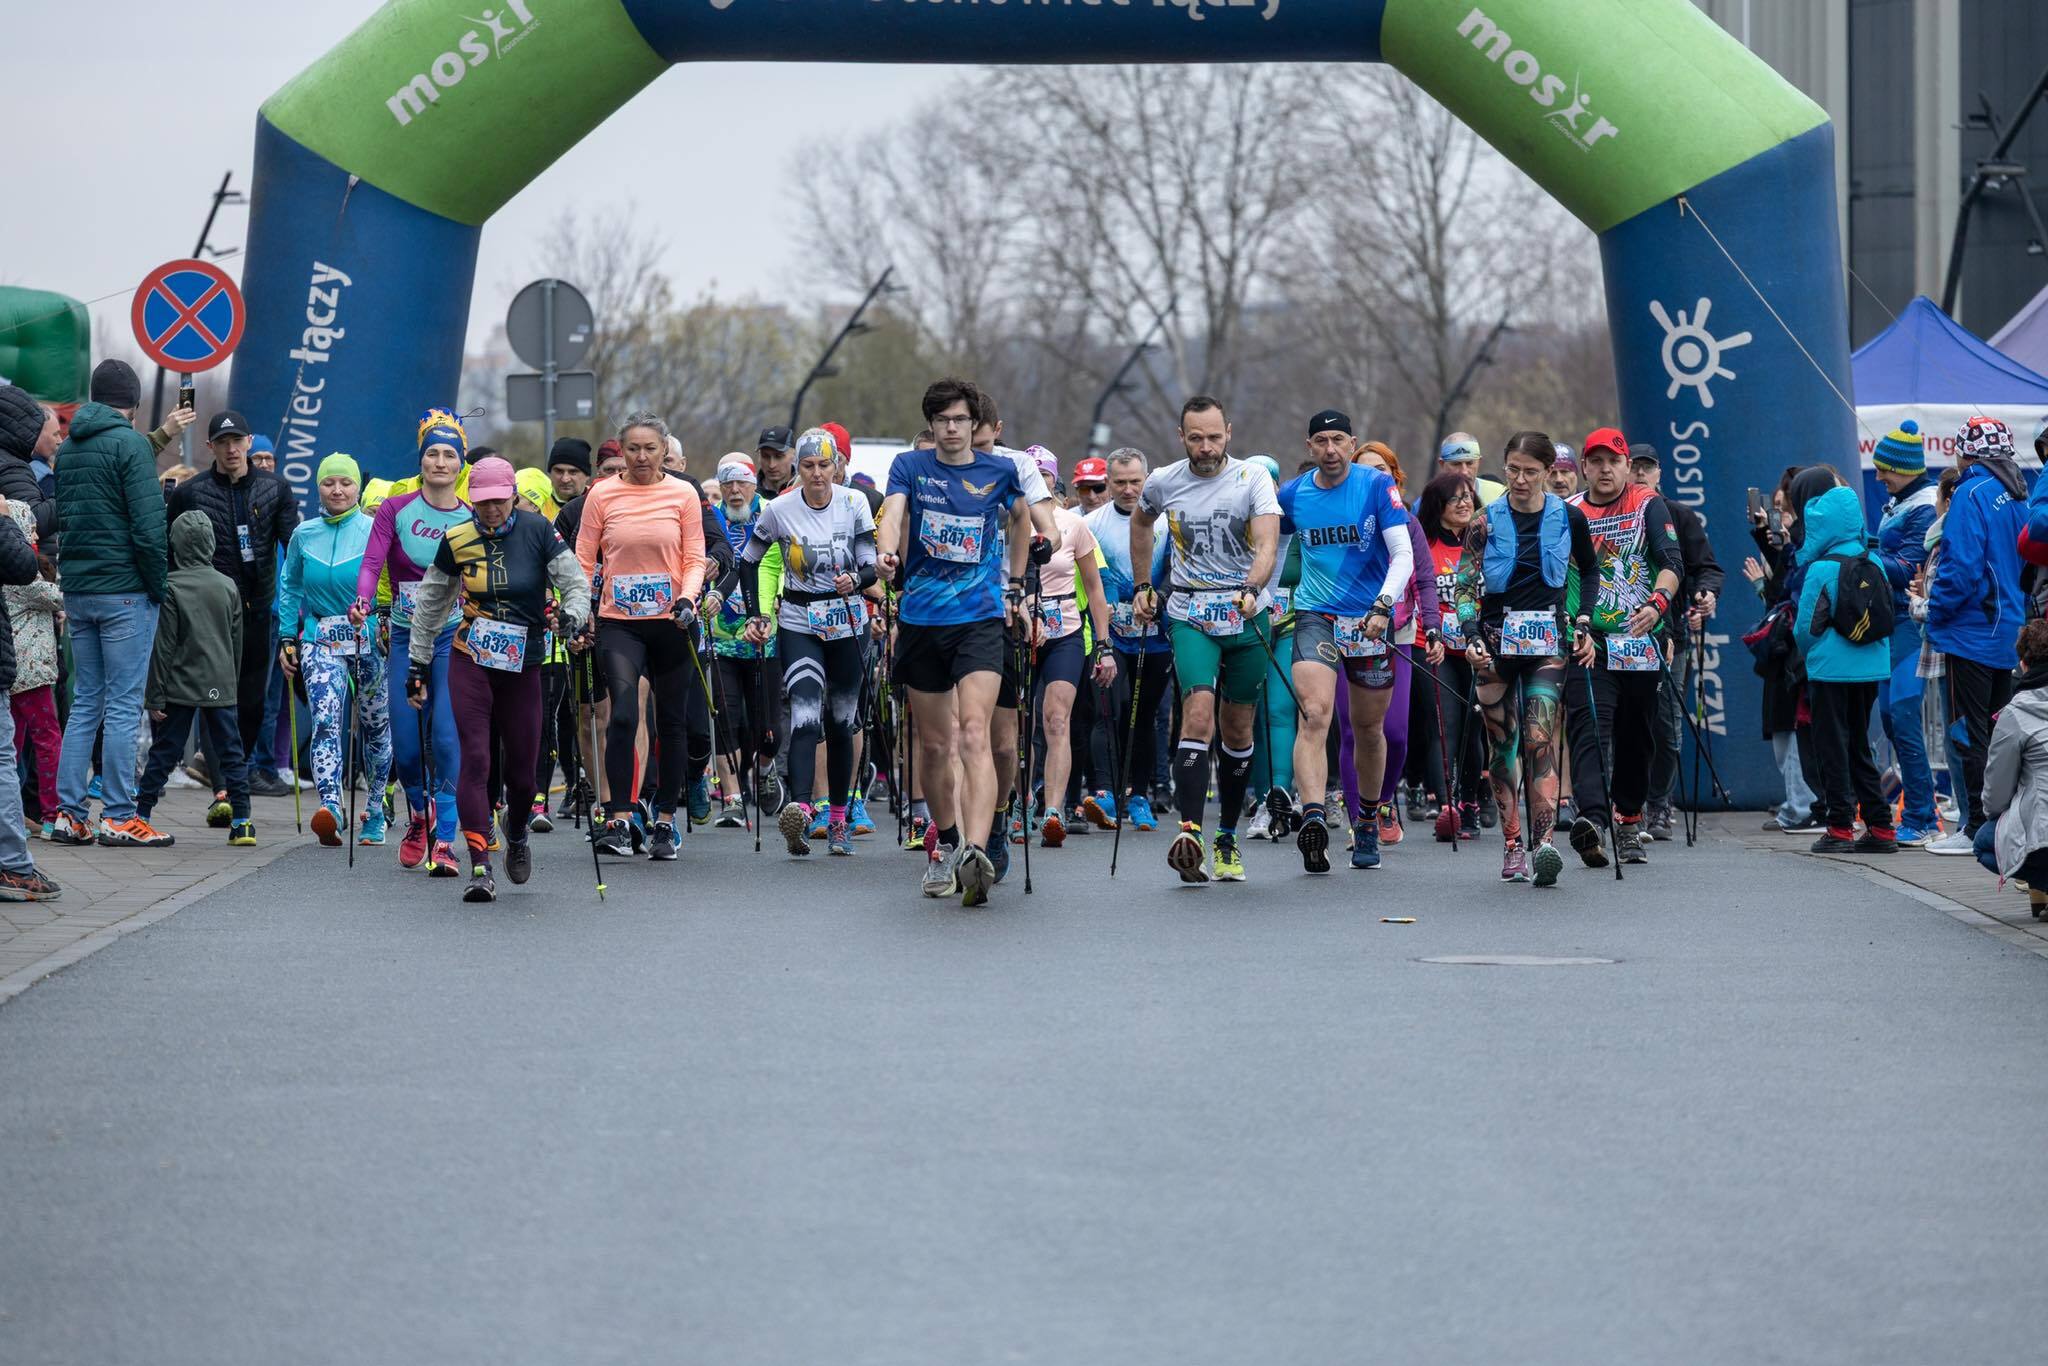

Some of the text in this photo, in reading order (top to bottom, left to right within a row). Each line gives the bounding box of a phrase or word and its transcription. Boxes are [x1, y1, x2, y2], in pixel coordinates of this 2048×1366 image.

[289, 261, 352, 364] łączy
[1309, 524, 1361, 546] BIEGA
[1589, 522, 1619, 534] UCHAR
[940, 529, 965, 547] 847
[488, 538, 509, 597] TEAM
[629, 588, 656, 603] 829
[825, 611, 847, 627] 870
[1204, 607, 1228, 621] 876
[328, 628, 354, 642] 866
[1518, 625, 1545, 640] 890
[481, 634, 510, 655] 832
[1623, 642, 1647, 657] 852
